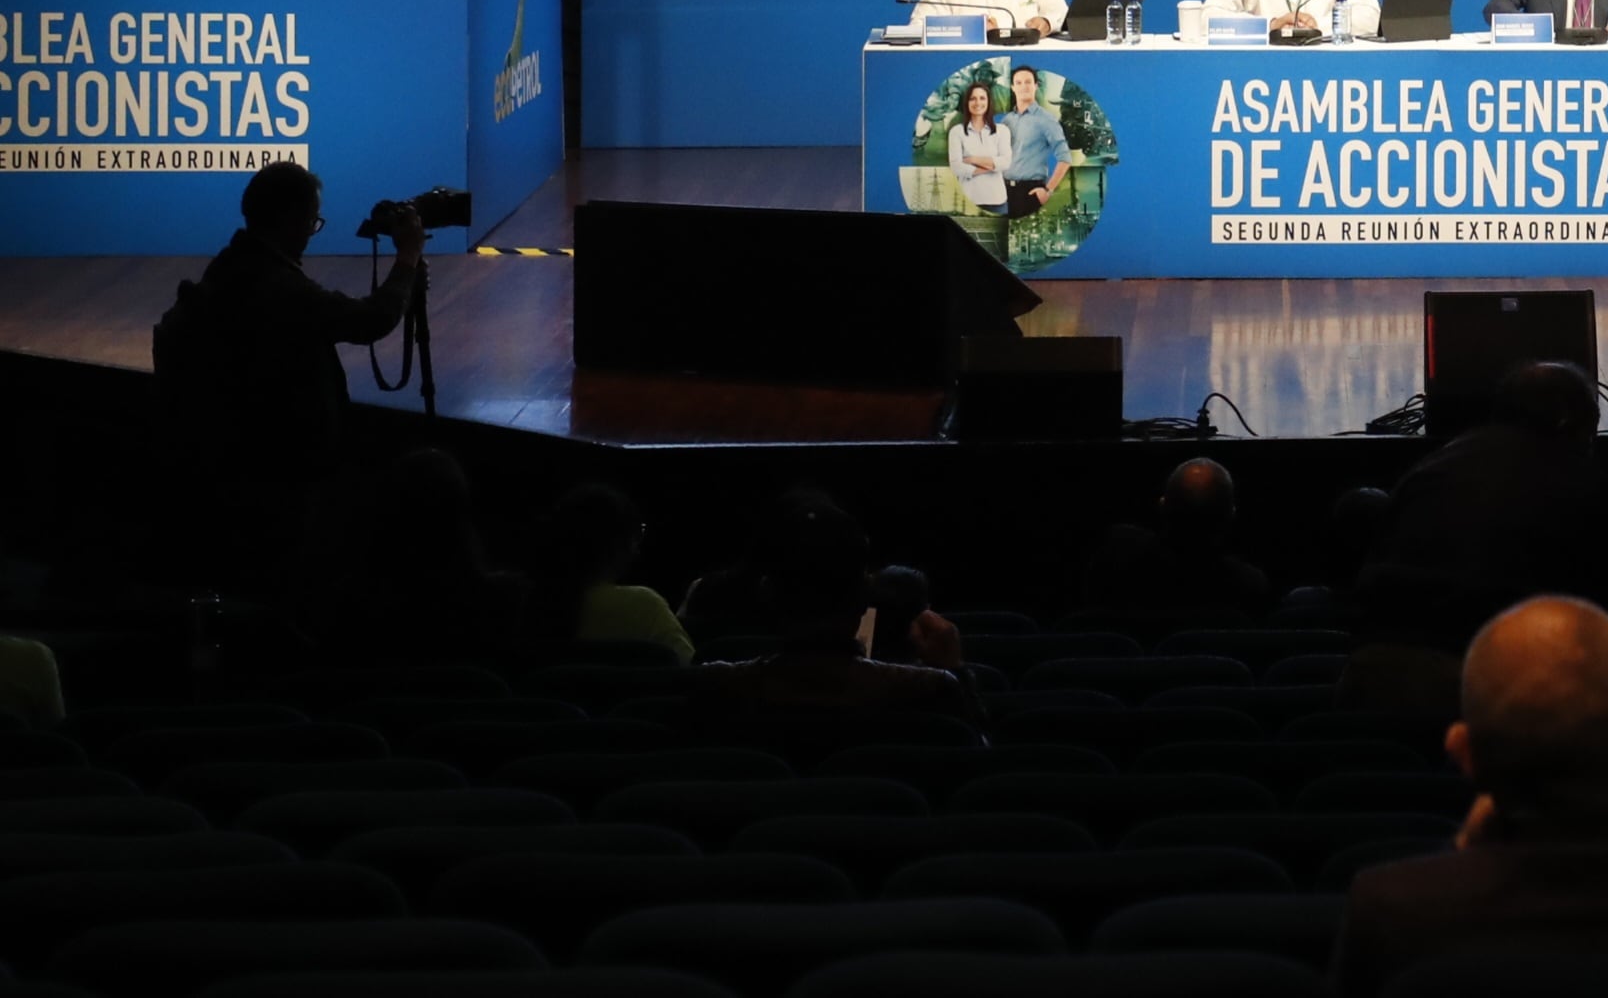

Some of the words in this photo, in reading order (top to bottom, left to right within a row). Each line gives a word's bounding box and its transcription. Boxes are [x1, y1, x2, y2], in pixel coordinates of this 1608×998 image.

[110, 12, 310, 65] GENERAL
[1211, 79, 1452, 133] ASAMBLEA
[1211, 140, 1281, 208] DE
[1222, 221, 1327, 241] SEGUNDA
[1341, 218, 1440, 241] REUNIÓN
